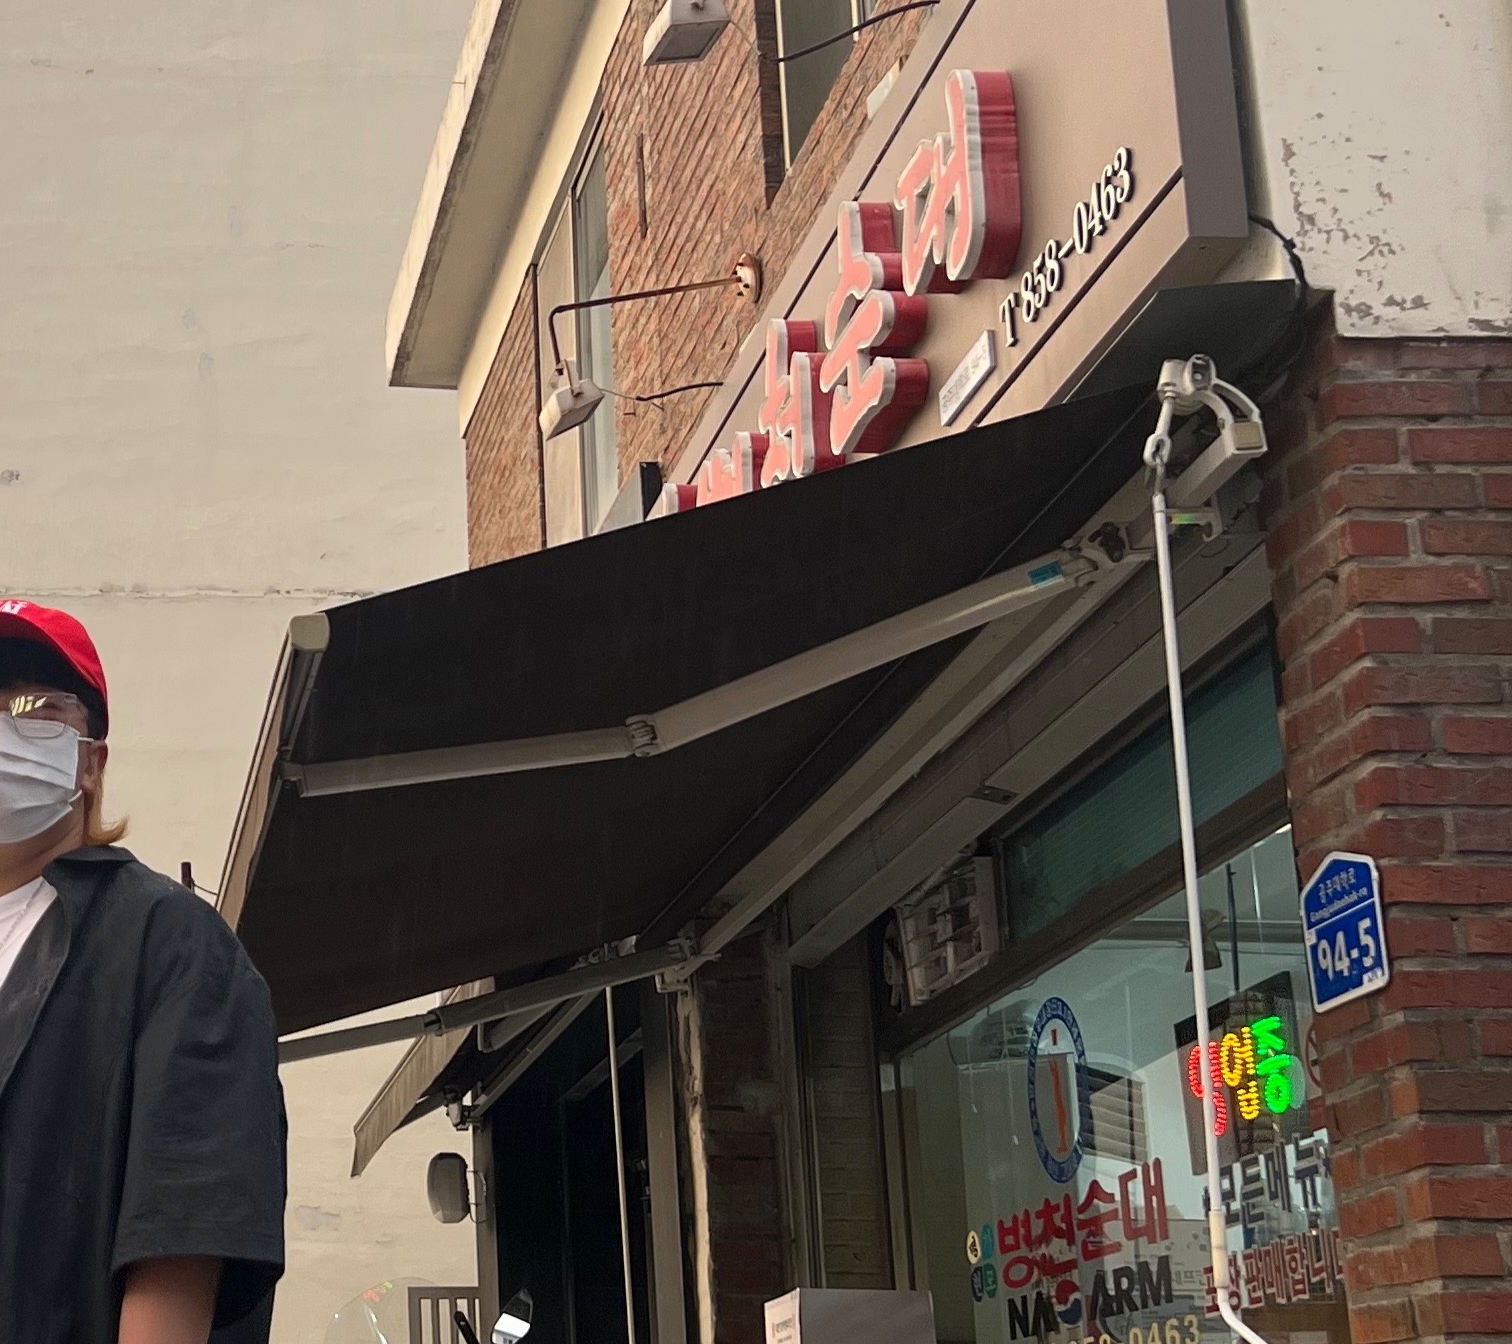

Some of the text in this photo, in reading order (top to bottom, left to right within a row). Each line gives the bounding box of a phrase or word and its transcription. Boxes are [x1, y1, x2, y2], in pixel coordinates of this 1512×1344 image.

[1000, 145, 1135, 348] T 858-0463
[1317, 916, 1376, 982] 94-5
[1189, 1015, 1291, 1137] 영업중
[997, 1157, 1170, 1289] 병천순대
